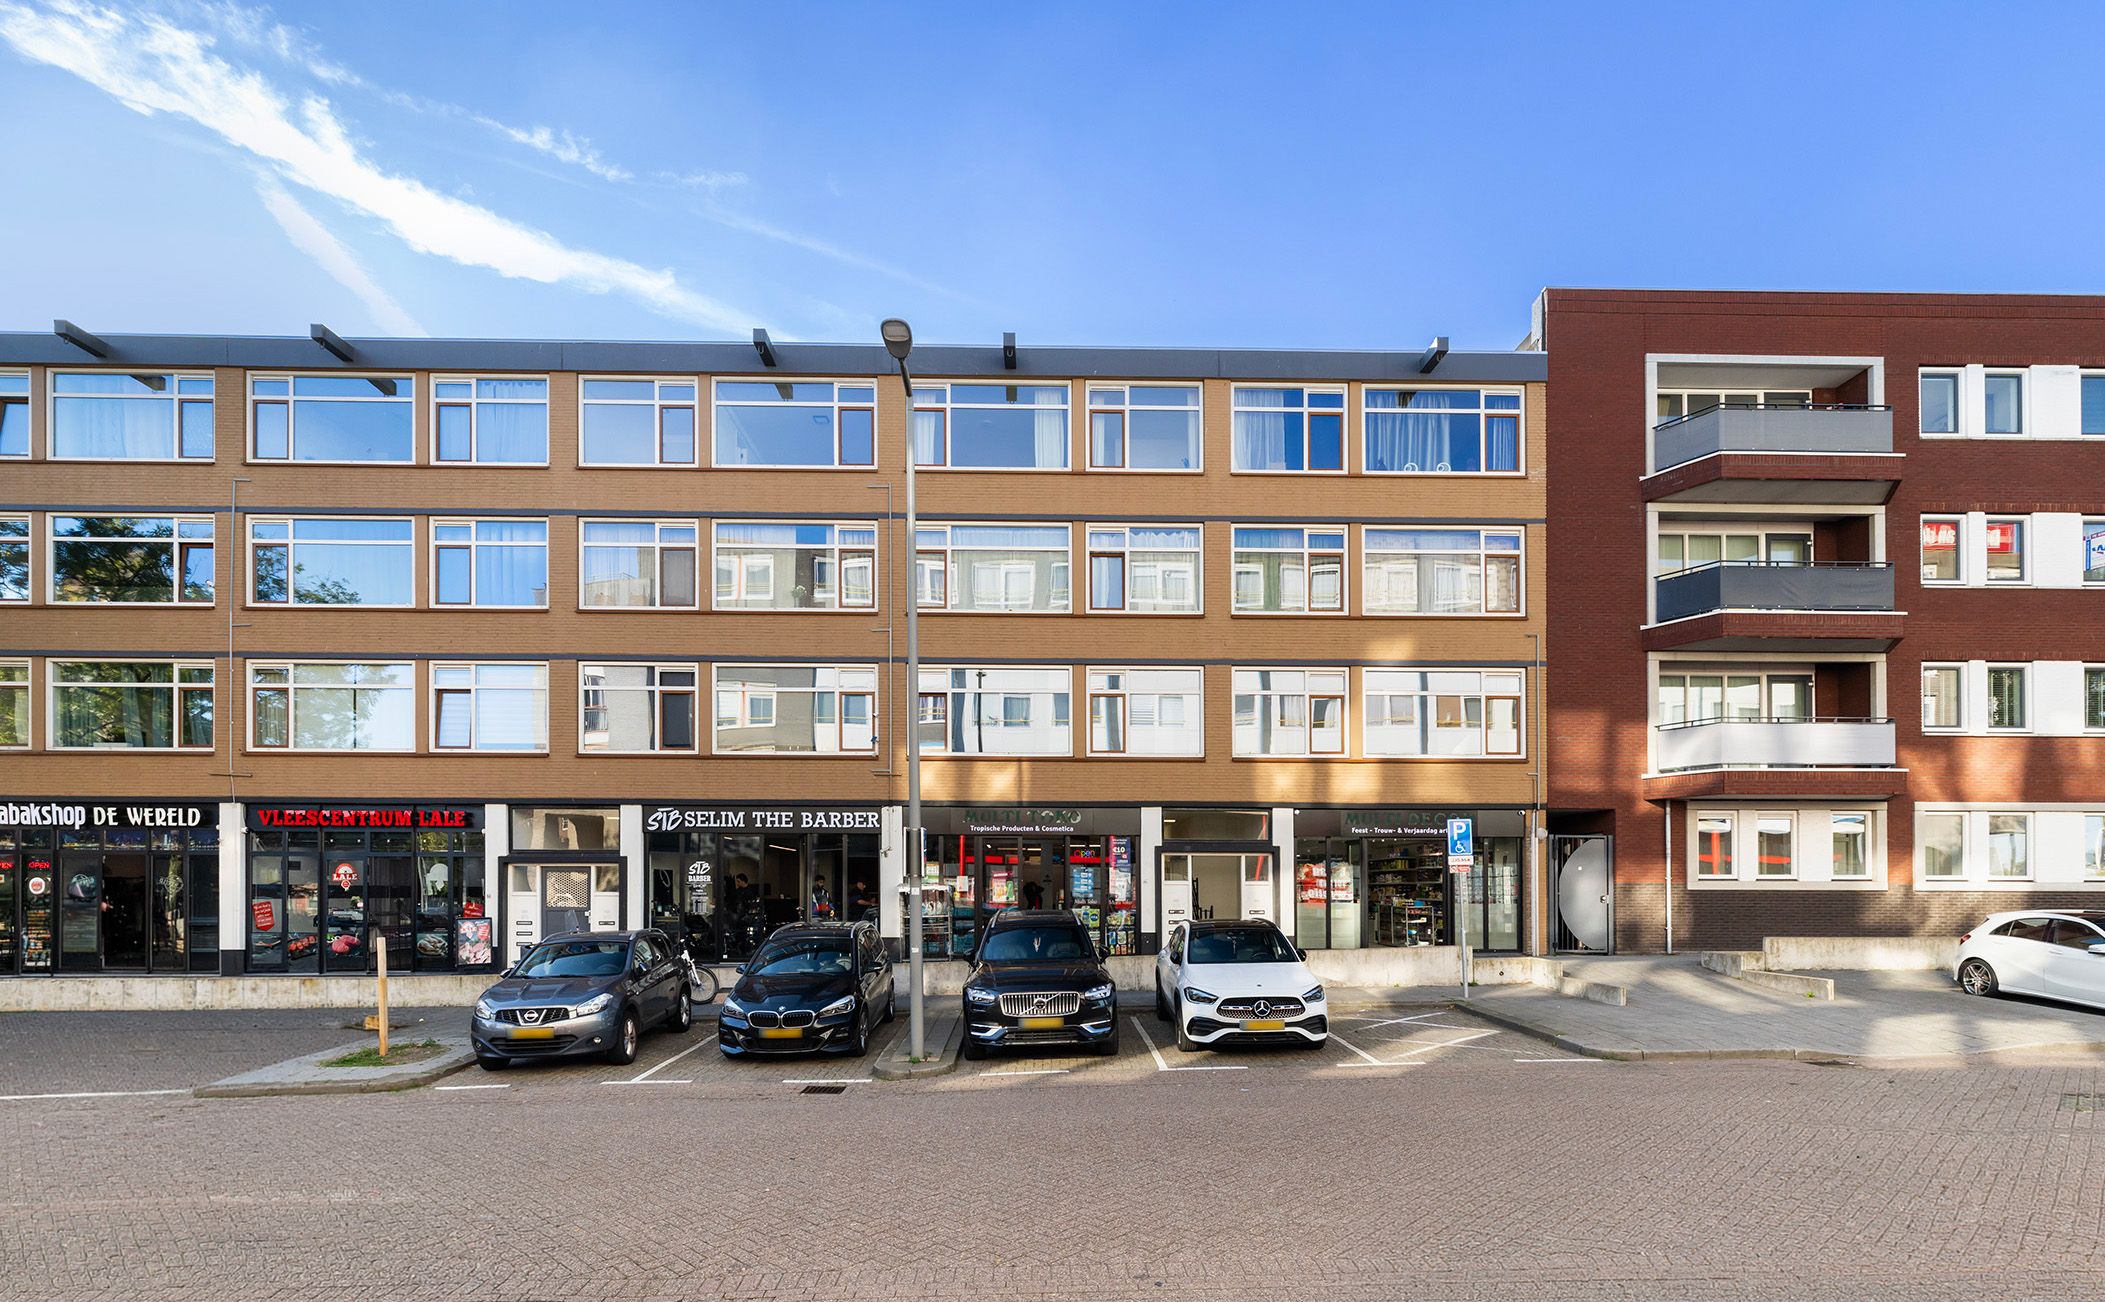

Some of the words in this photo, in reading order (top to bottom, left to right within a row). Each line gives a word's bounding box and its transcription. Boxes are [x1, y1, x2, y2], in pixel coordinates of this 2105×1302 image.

[93, 807, 119, 826] DE
[127, 807, 201, 827] WERELD
[257, 810, 412, 827] VLEESCENTRUM
[418, 810, 466, 827] LALE
[647, 807, 683, 832] STB
[685, 811, 745, 828] SELIM
[752, 811, 793, 828] THE
[801, 811, 880, 828] BARBER
[963, 809, 1020, 824] MULTI
[1026, 809, 1081, 824] TOKO
[1404, 827, 1438, 835] Verjaardag
[1453, 821, 1467, 841] P
[28, 861, 50, 869] OPEN
[688, 861, 711, 875] STB
[332, 873, 358, 881] LALE
